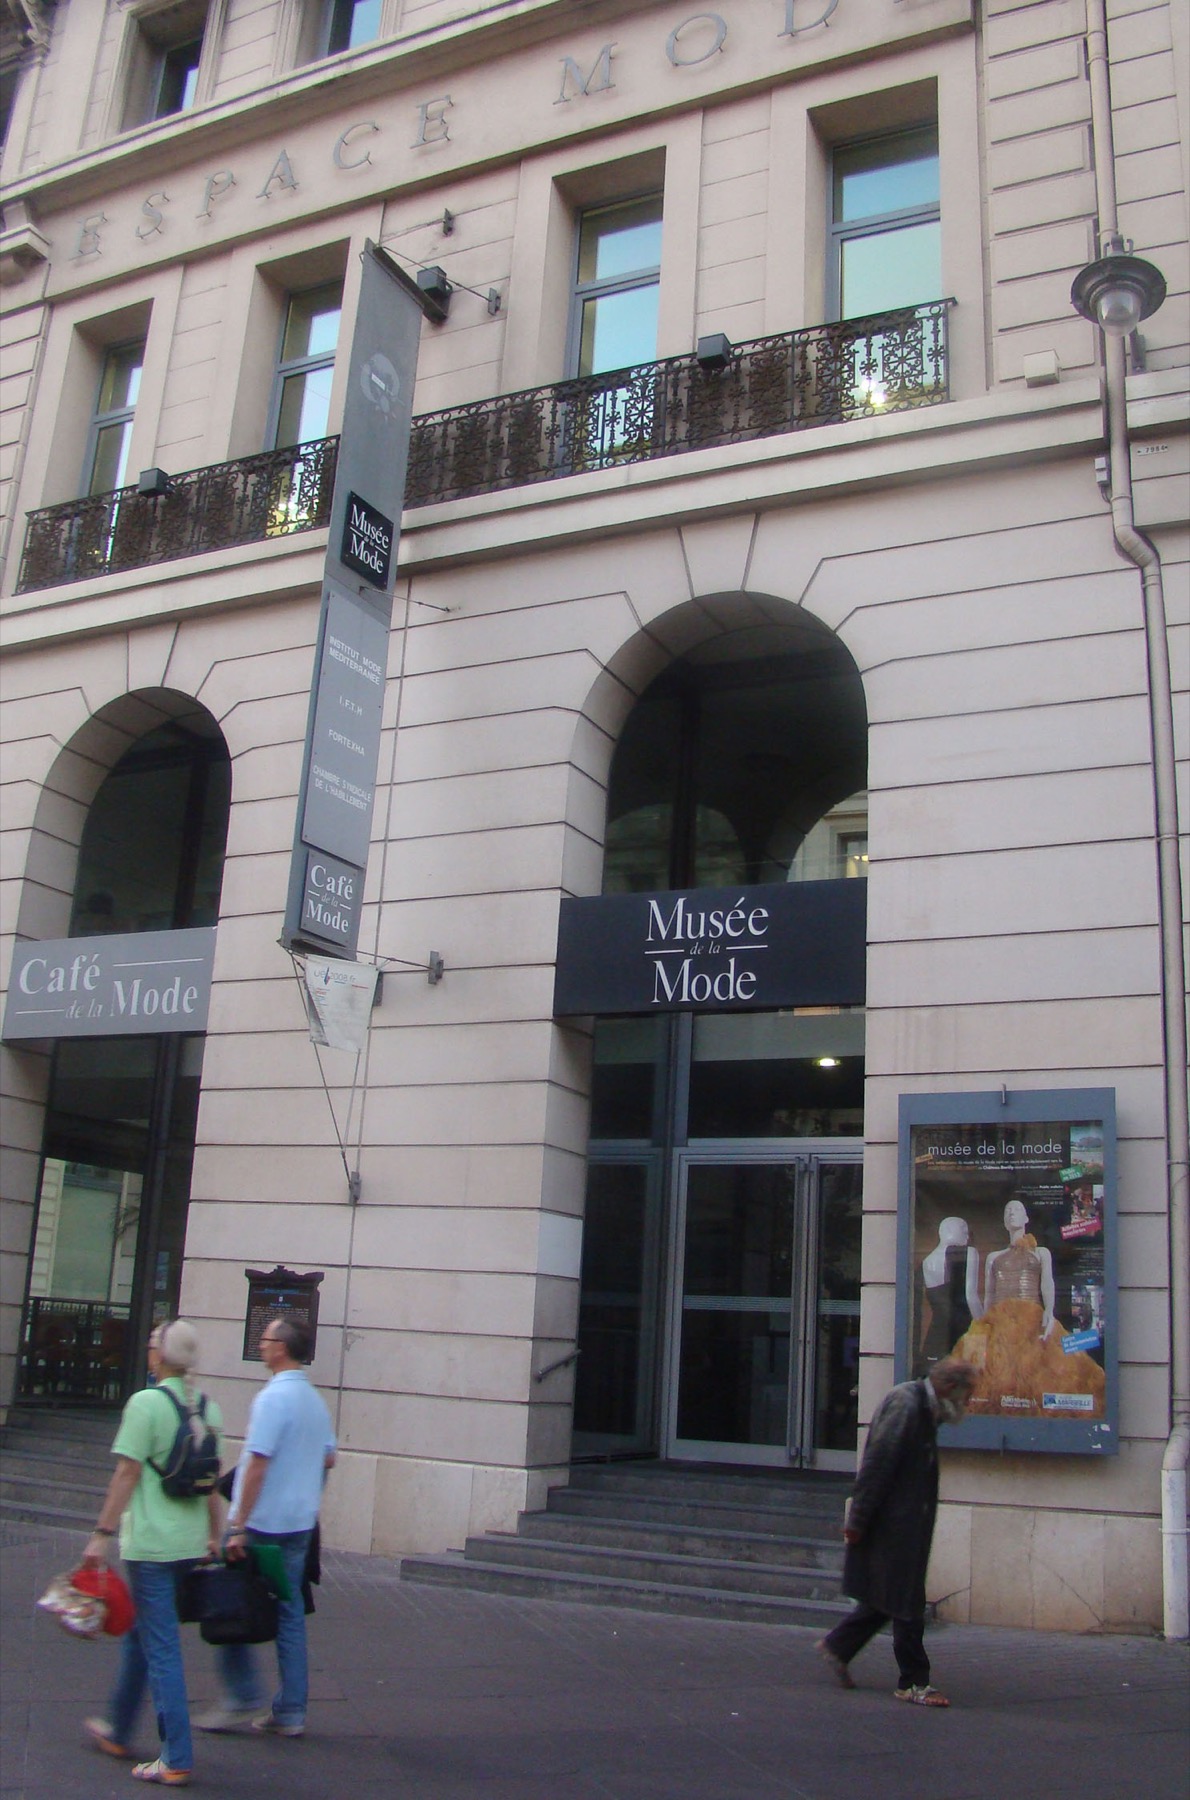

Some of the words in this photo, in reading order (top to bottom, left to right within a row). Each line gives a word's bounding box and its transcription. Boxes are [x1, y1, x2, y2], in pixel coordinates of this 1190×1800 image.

[69, 94, 455, 262] ESPACE
[552, 0, 905, 105] MOD
[350, 503, 389, 549] Musée
[350, 533, 384, 574] Mode
[329, 635, 360, 661] INSTITUT
[362, 656, 382, 676] MODE
[312, 764, 341, 786] CHAMBRE
[342, 779, 372, 802] SYNDICALE
[314, 778, 324, 790] DE
[310, 864, 354, 901] Café
[320, 892, 331, 905] de
[331, 895, 339, 908] la
[306, 899, 350, 934] Mode
[645, 896, 770, 942] Musée
[689, 941, 703, 956] de
[708, 940, 722, 955] la
[19, 953, 101, 995] Café
[650, 957, 757, 1004] Mode
[65, 999, 82, 1019] de
[87, 998, 103, 1018] la
[109, 976, 199, 1018] Mode
[928, 1142, 972, 1156] musée
[977, 1140, 996, 1156] de
[1002, 1139, 1016, 1155] la
[1021, 1138, 1063, 1155] mode
